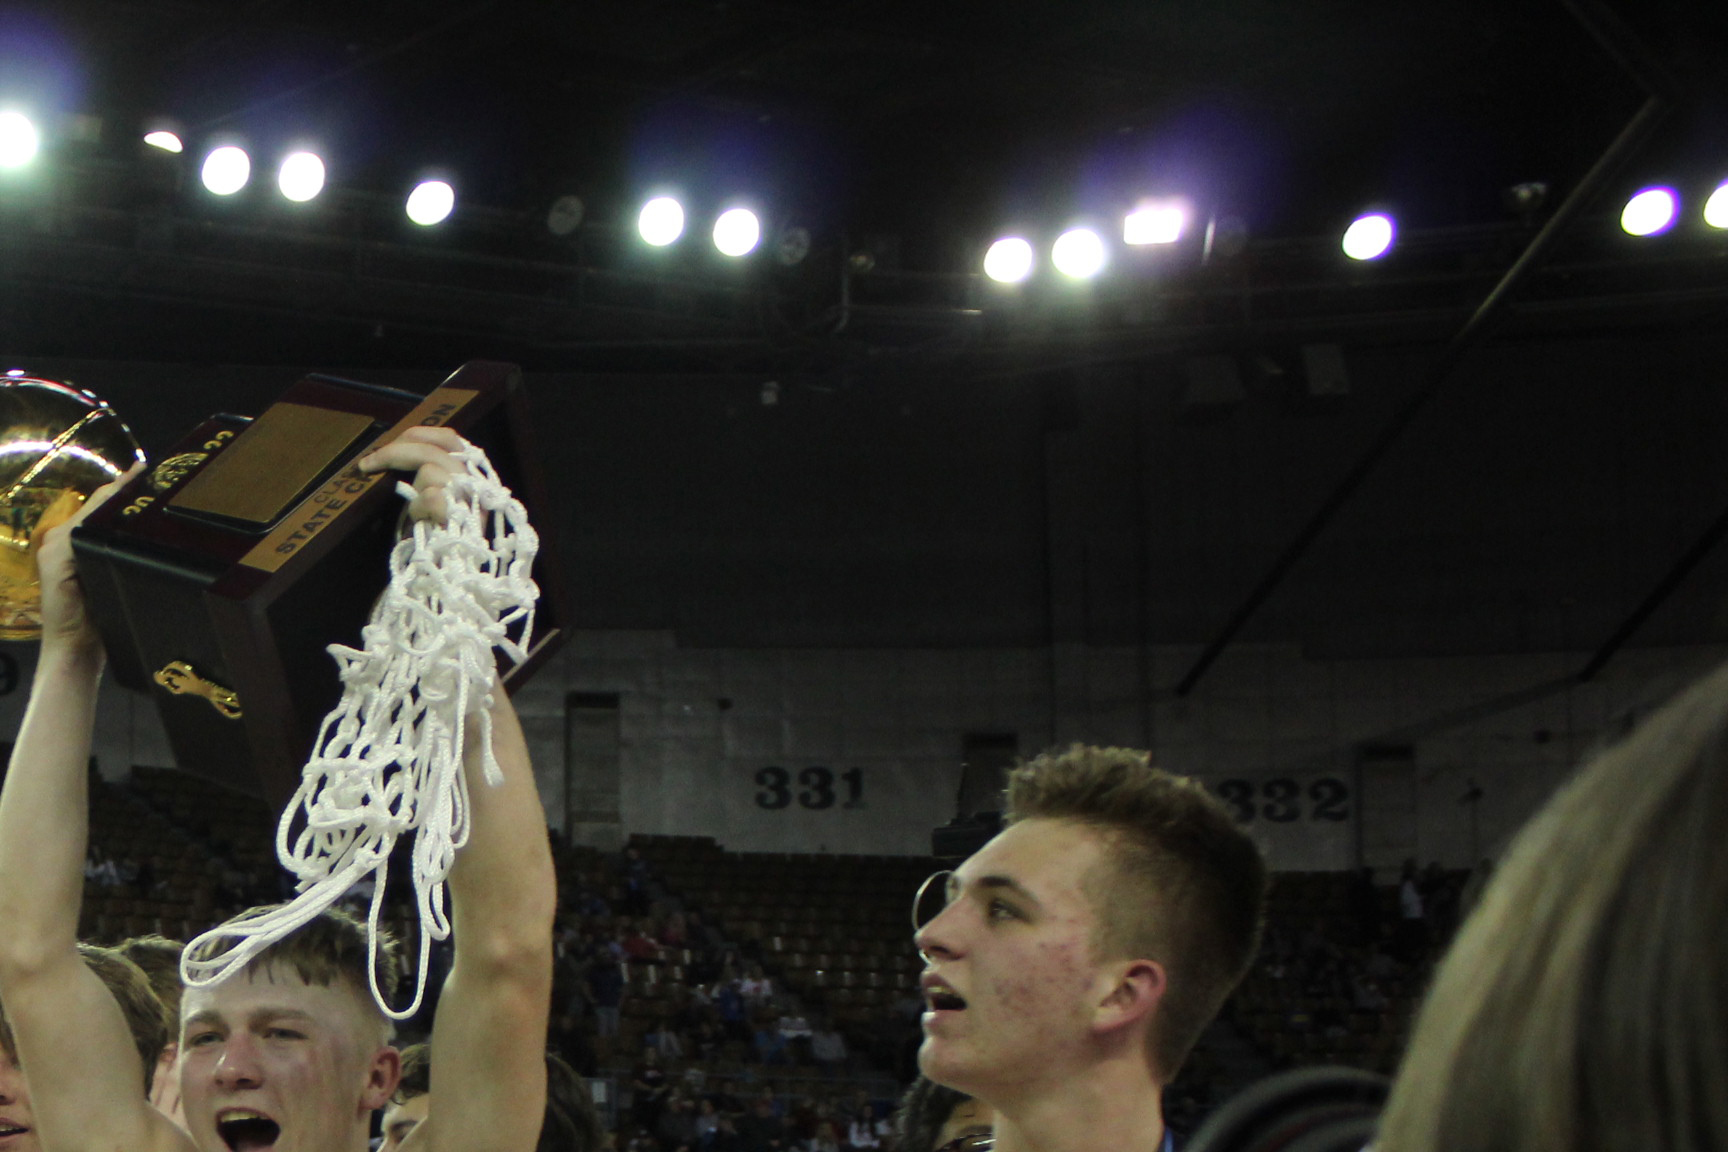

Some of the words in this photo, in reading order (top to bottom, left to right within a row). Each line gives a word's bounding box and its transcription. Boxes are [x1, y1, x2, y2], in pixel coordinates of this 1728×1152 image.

[276, 500, 347, 554] STATE
[755, 766, 868, 809] 331
[1219, 778, 1349, 822] 332
